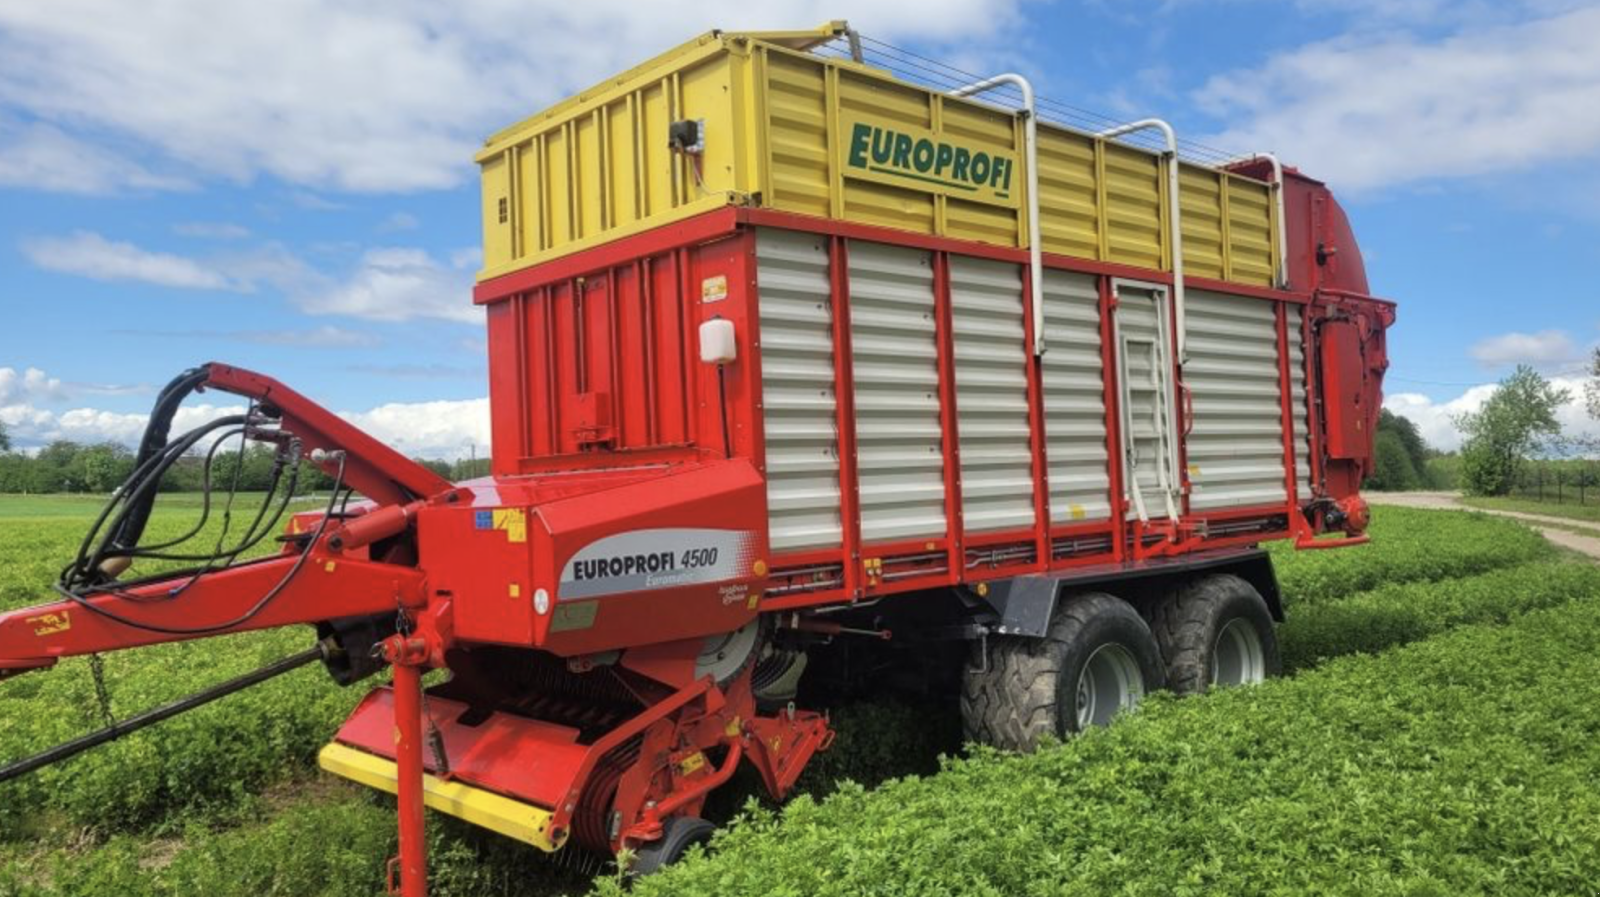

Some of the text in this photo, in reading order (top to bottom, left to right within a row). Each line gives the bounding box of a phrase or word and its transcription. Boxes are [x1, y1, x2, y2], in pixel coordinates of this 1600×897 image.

[848, 122, 1013, 191] EUROPROFI
[573, 547, 718, 581] EUROPROFI 4500
